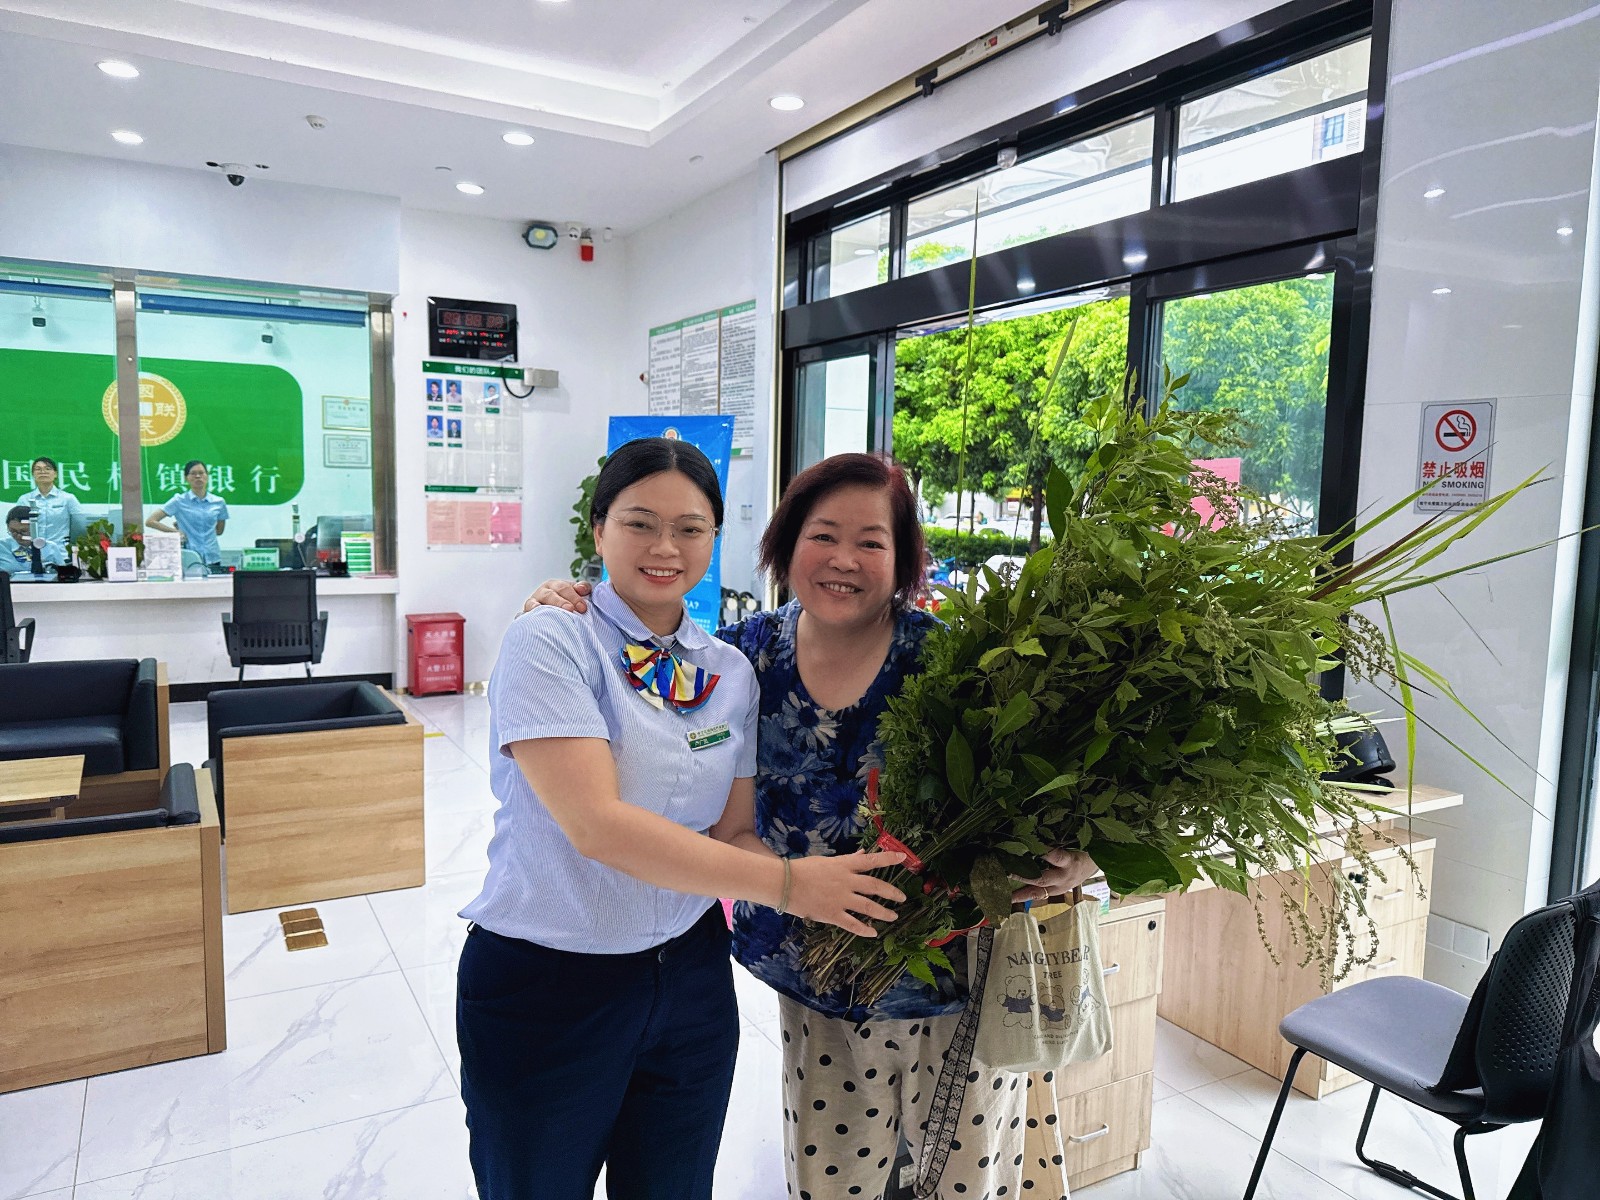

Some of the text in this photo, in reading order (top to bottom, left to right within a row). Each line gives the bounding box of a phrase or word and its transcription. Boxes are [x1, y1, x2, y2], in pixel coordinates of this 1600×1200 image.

[1422, 461, 1485, 479] 禁止吸烟
[1422, 480, 1484, 489] N SMOKING
[1042, 970, 1063, 980] TREE
